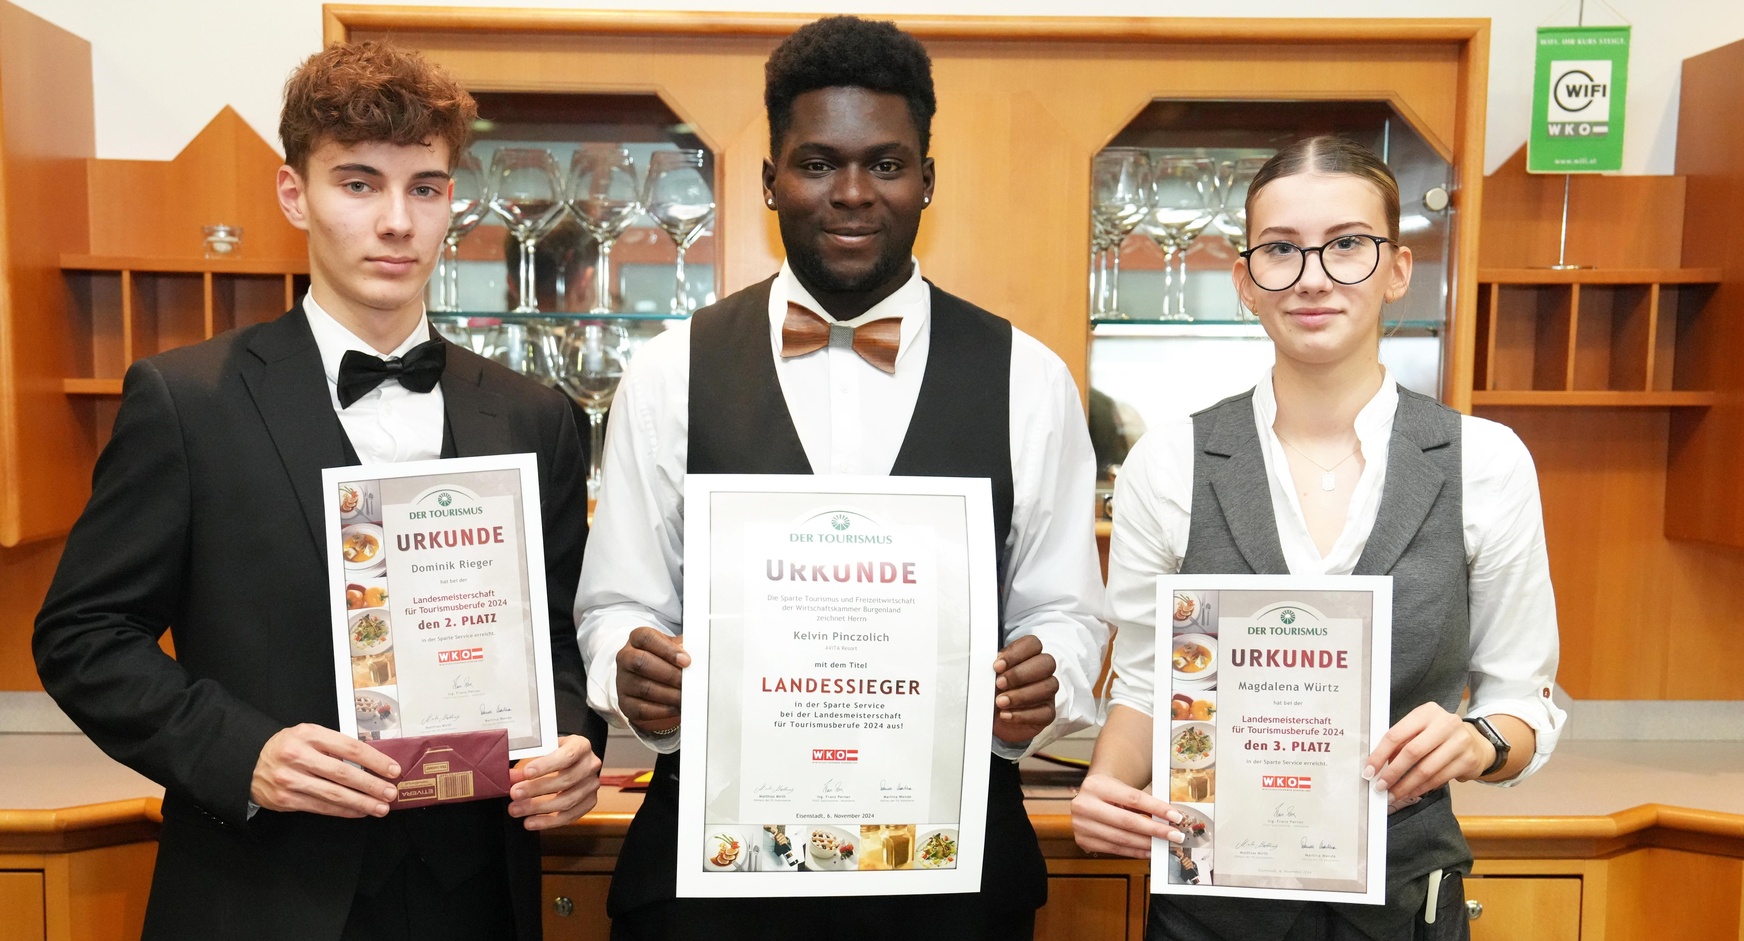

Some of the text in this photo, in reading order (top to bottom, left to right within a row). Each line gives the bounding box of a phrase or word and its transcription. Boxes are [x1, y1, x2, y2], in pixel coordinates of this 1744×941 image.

[1566, 84, 1606, 98] WIFI
[1548, 124, 1590, 136] WKO
[409, 507, 483, 520] DER TOURISMUS
[396, 526, 505, 552] URKUNDE
[790, 533, 892, 544] DER TOURISMUS
[411, 559, 493, 574] Dominik Rieger
[766, 559, 917, 584] URKUNDE
[413, 590, 495, 604] Landesmeisterschaft
[780, 595, 803, 603] Sparte
[419, 602, 486, 614] Tourismusberufe
[488, 599, 507, 608] 2024
[418, 613, 497, 630] den 2. PLATZ
[438, 634, 454, 642] Sparte
[474, 631, 496, 639] erreicht.
[793, 631, 890, 642] Kelvin Pinczolich
[1248, 627, 1328, 636] DER TOURISMUS
[439, 651, 471, 662] WKO
[1232, 649, 1348, 668] URKUNDE
[762, 677, 920, 695] LANDESSIEGER
[1238, 682, 1339, 692] Magdalena Würtz
[1242, 715, 1332, 725] Landesmeisterschaft
[1247, 726, 1320, 735] Tourismusberufe
[1244, 740, 1331, 752] den 3. PLATZ
[813, 751, 845, 760] WKO
[1263, 777, 1298, 787] WKO
[401, 788, 434, 796] ETIVERA
